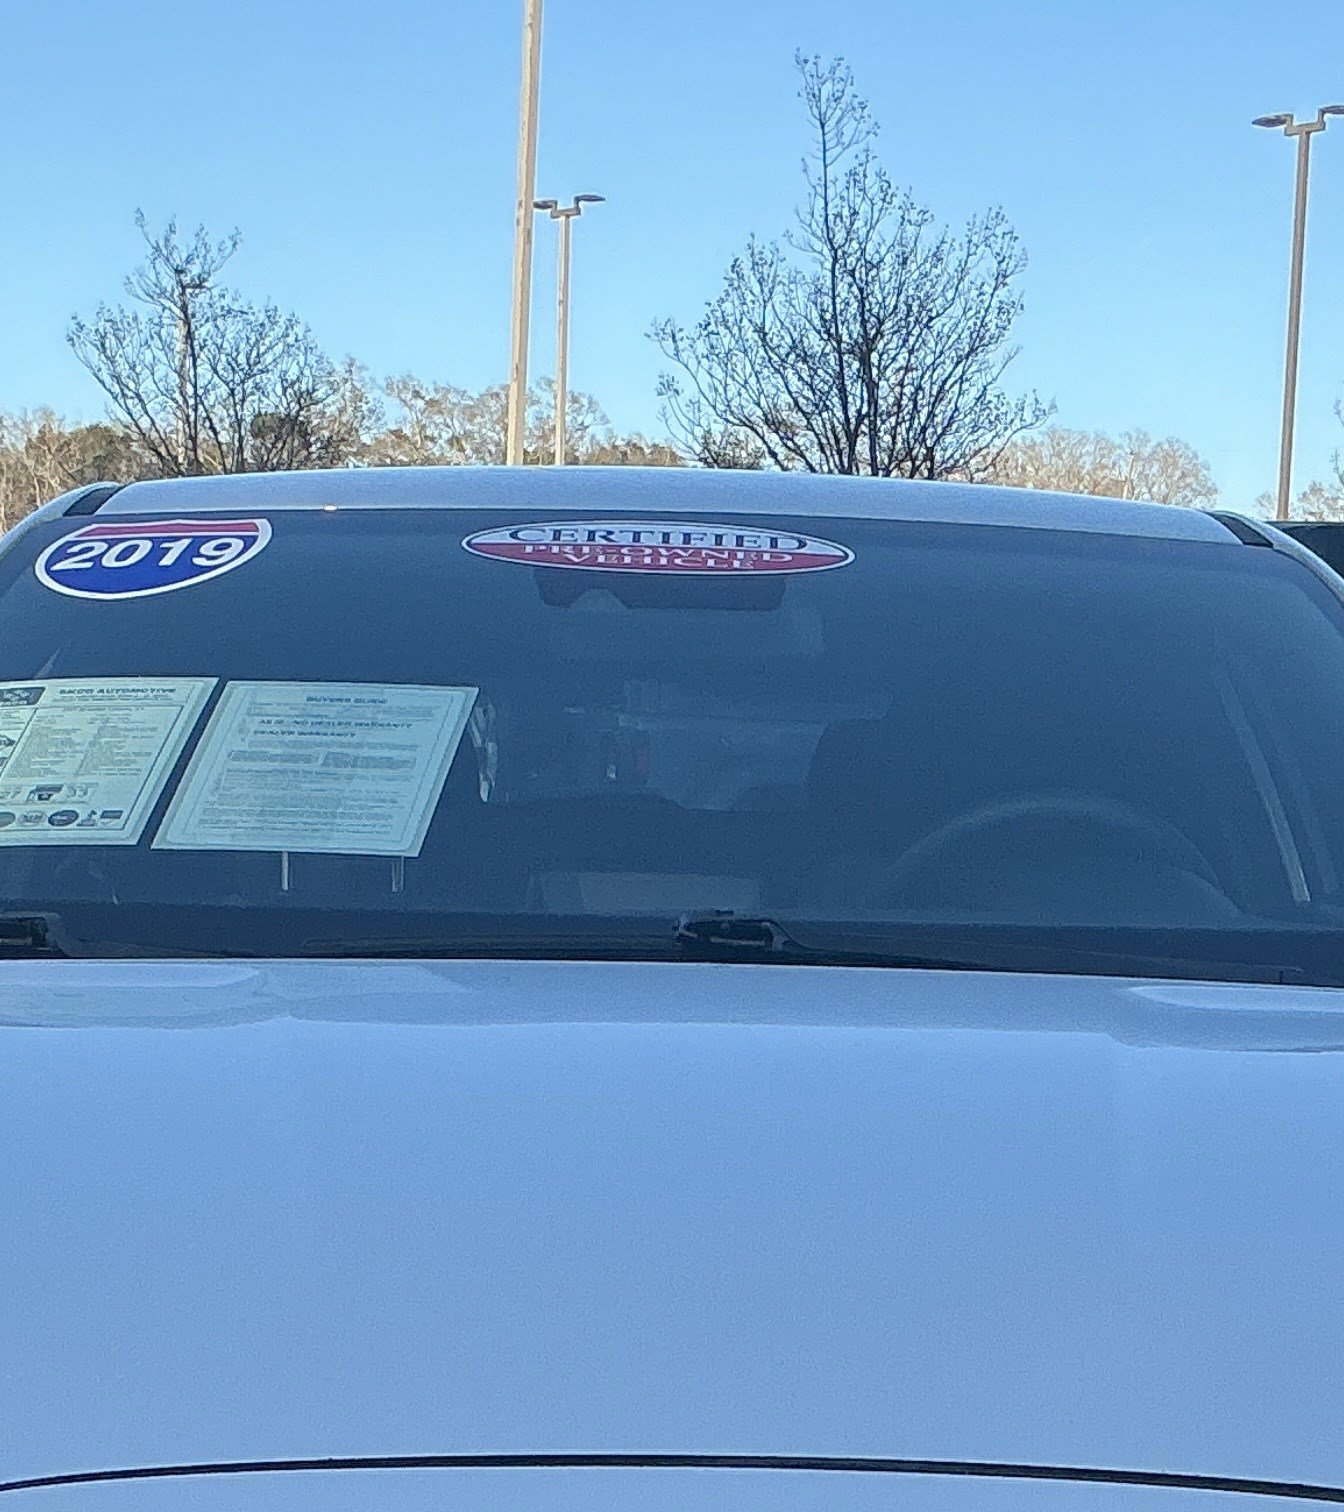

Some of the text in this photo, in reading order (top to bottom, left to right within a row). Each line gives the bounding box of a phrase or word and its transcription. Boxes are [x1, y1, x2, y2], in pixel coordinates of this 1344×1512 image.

[508, 527, 809, 551] CERTIFIED
[50, 537, 245, 571] 2019
[524, 544, 795, 563] PRE-OWNED
[564, 553, 757, 570] VEHICLE
